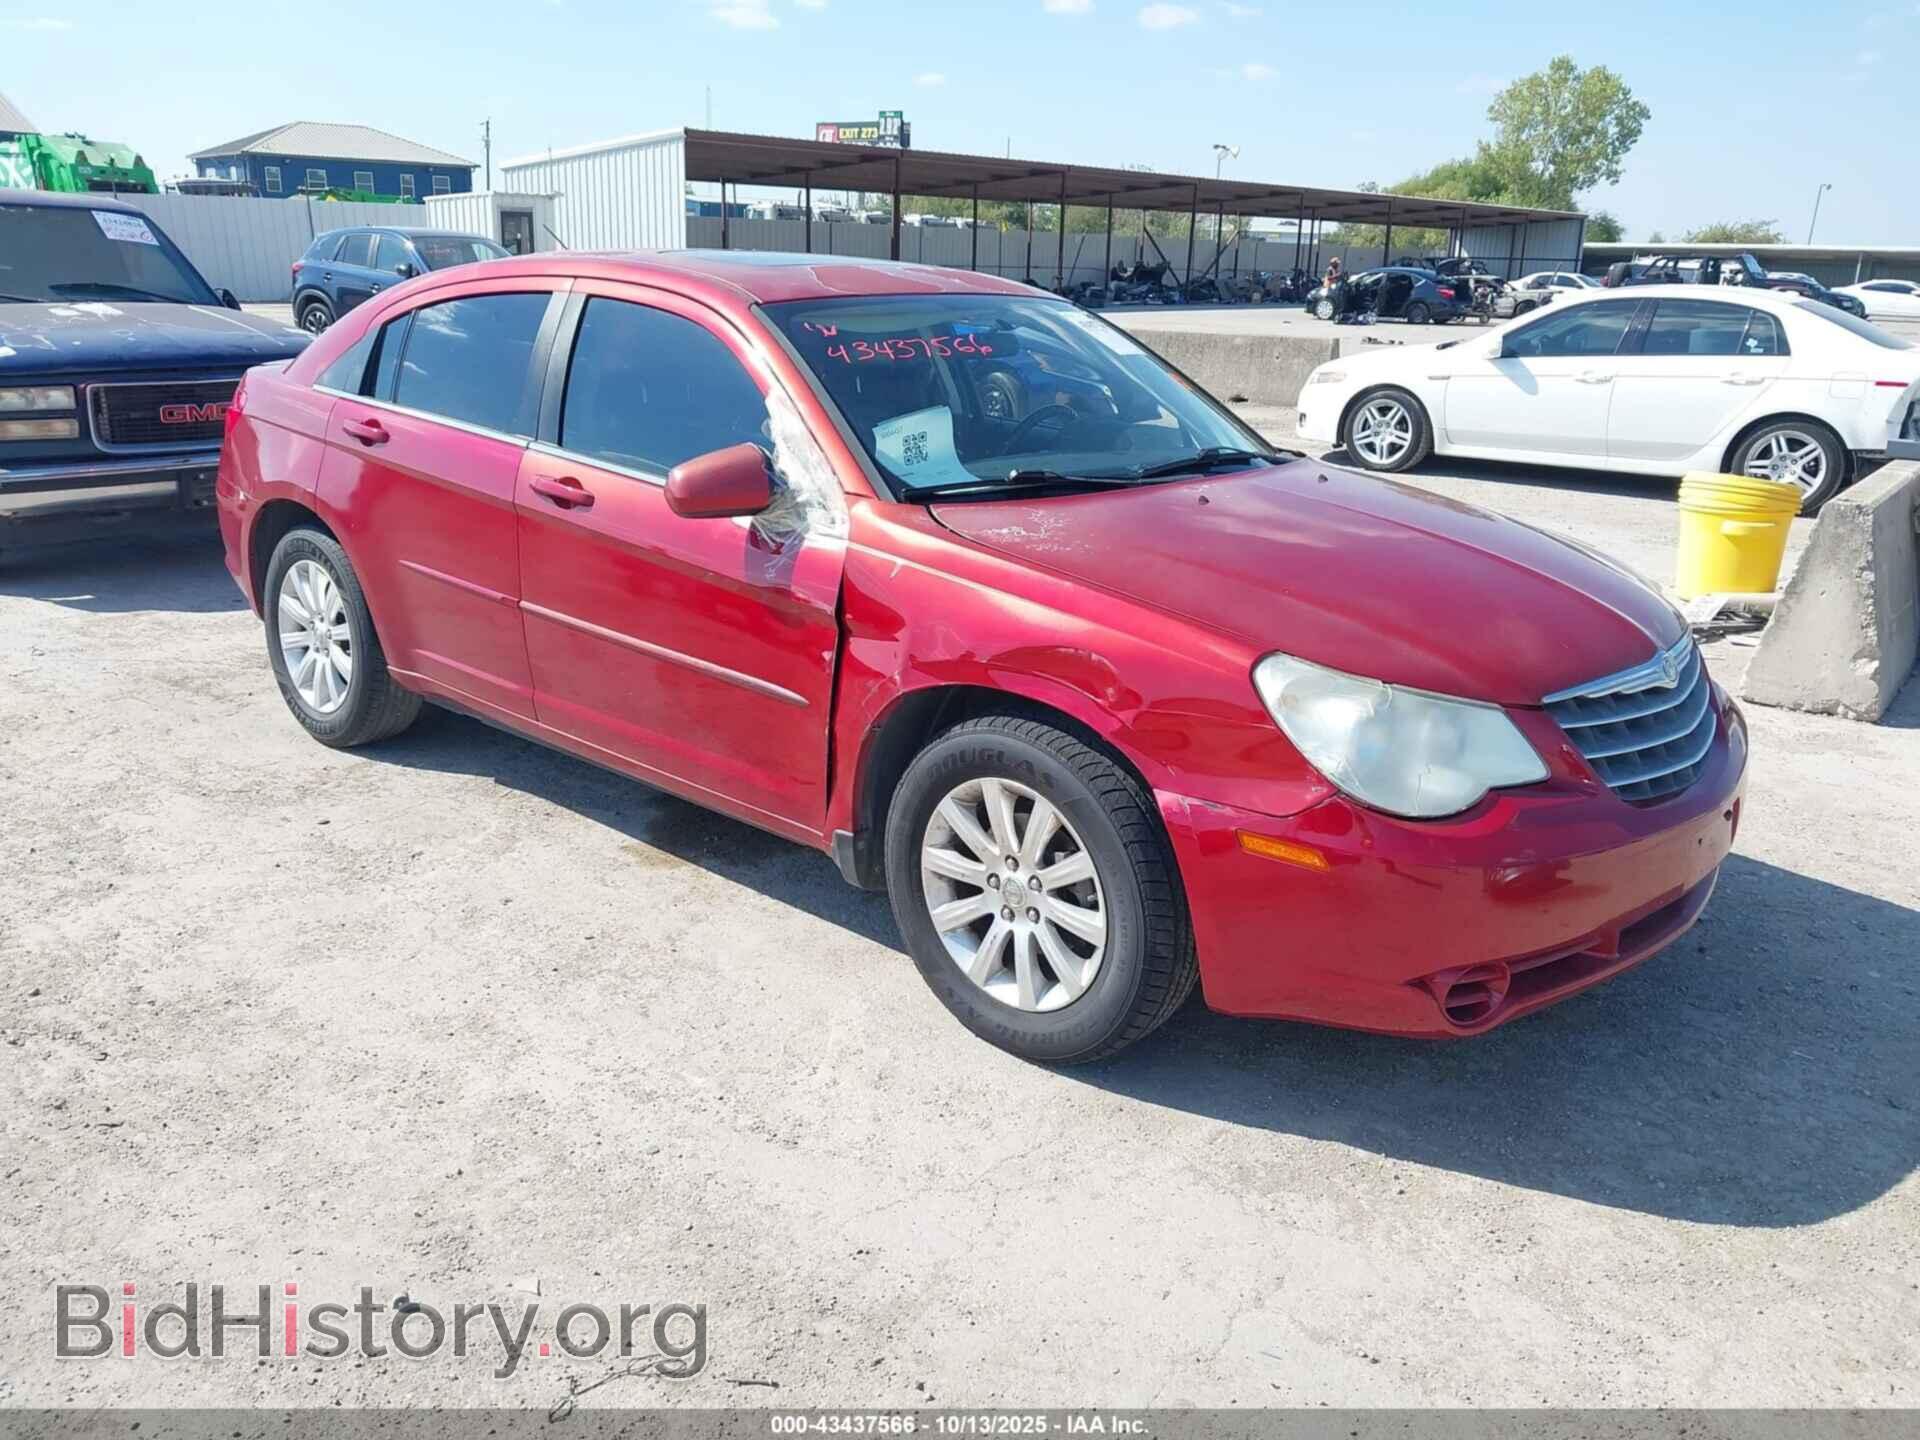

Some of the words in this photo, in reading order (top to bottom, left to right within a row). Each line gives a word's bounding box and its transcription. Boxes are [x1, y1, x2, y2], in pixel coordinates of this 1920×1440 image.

[839, 127, 860, 139] EXIT
[861, 127, 879, 139] 273
[827, 333, 993, 364] 43437566
